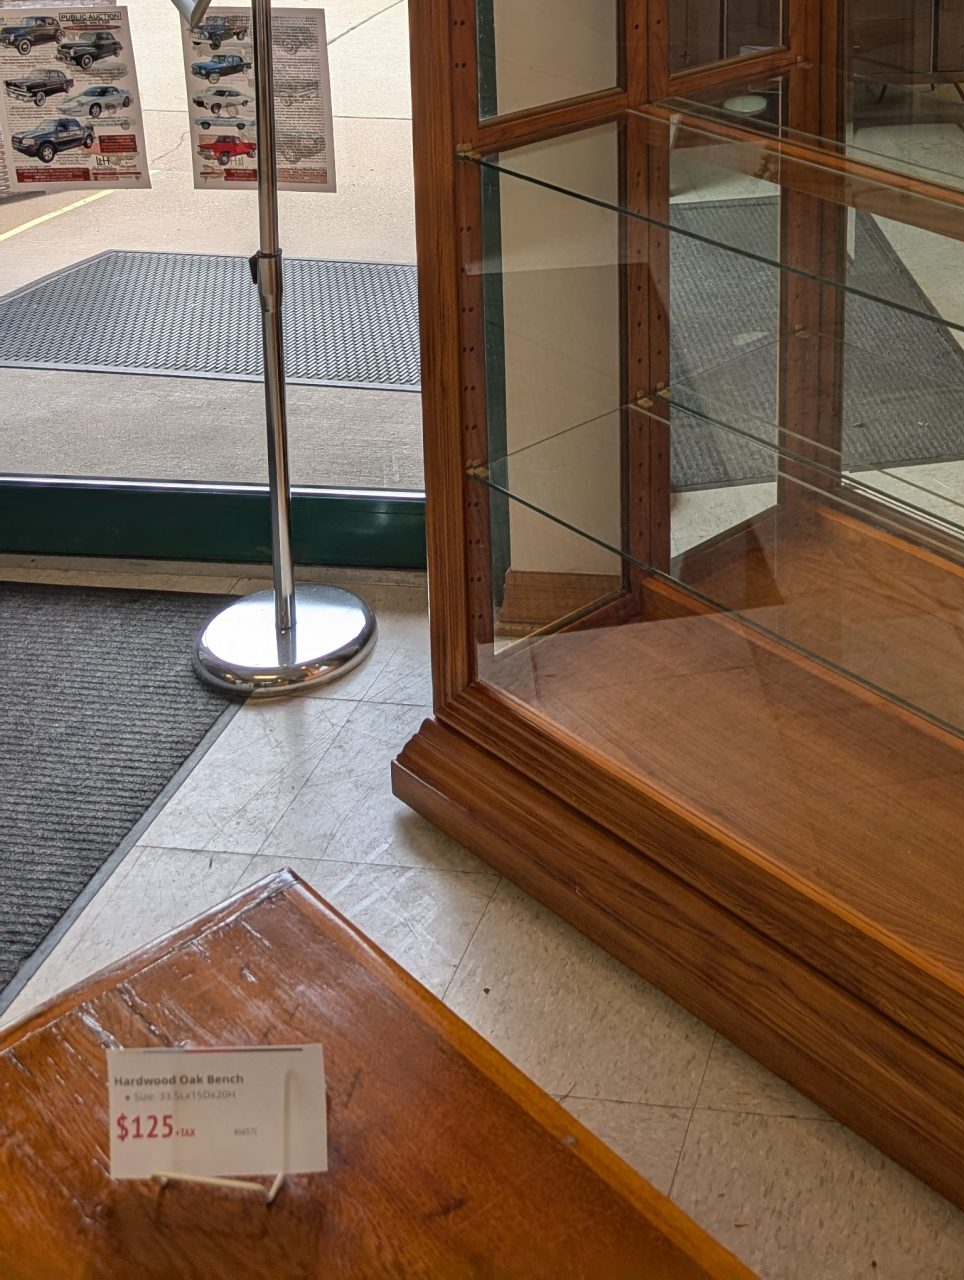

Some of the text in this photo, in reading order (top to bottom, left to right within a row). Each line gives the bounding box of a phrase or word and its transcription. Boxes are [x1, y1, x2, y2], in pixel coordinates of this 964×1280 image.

[89, 13, 120, 21] AUCTION
[114, 1073, 244, 1087] Hardwood Oak Bench
[117, 1113, 173, 1142] $125
